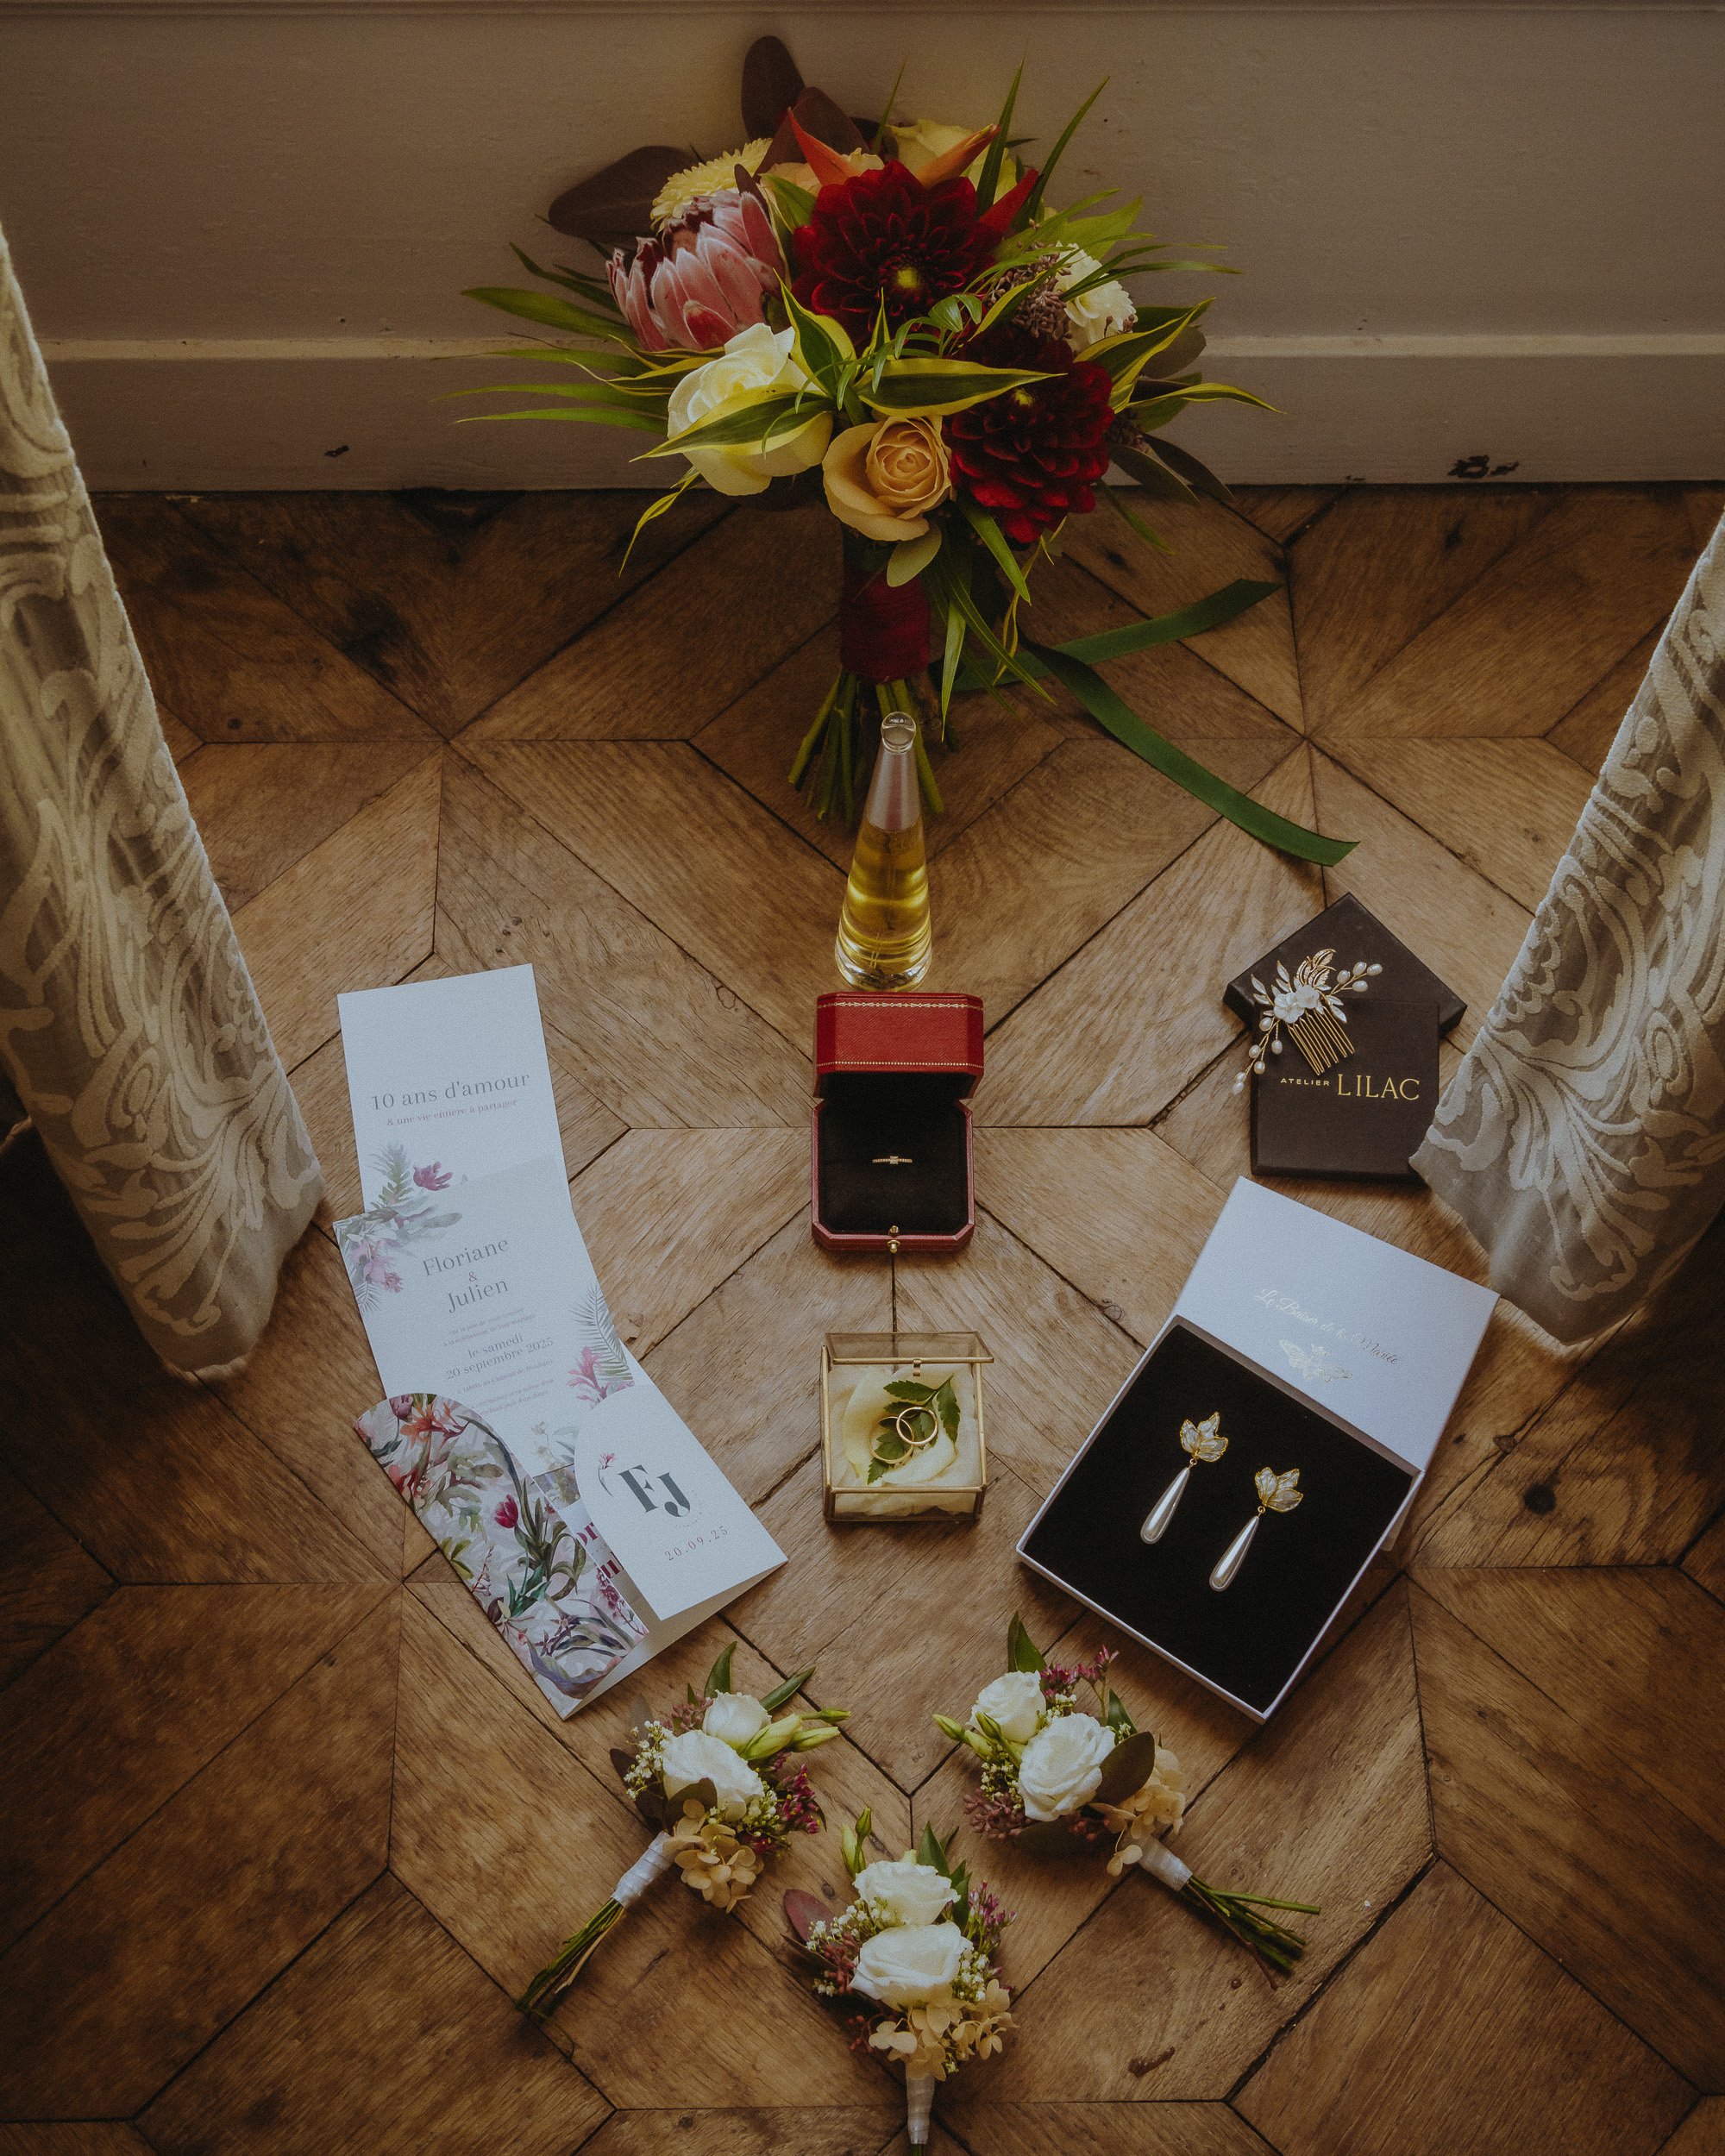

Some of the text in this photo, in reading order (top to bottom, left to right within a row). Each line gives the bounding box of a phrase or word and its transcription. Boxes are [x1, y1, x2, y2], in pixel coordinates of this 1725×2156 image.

[371, 1074, 530, 1111] 10 ans d'amour
[1280, 1074, 1420, 1100] ATELIER LILAC
[397, 1116, 415, 1125] une
[478, 1099, 518, 1114] partager
[423, 1239, 510, 1277] Floriane
[468, 1271, 478, 1282] &
[448, 1279, 509, 1313] Julien
[446, 1337, 554, 1380] 20 septembre 2025
[467, 1333, 524, 1359] le samedi
[664, 1525, 728, 1561] 20.09.25
